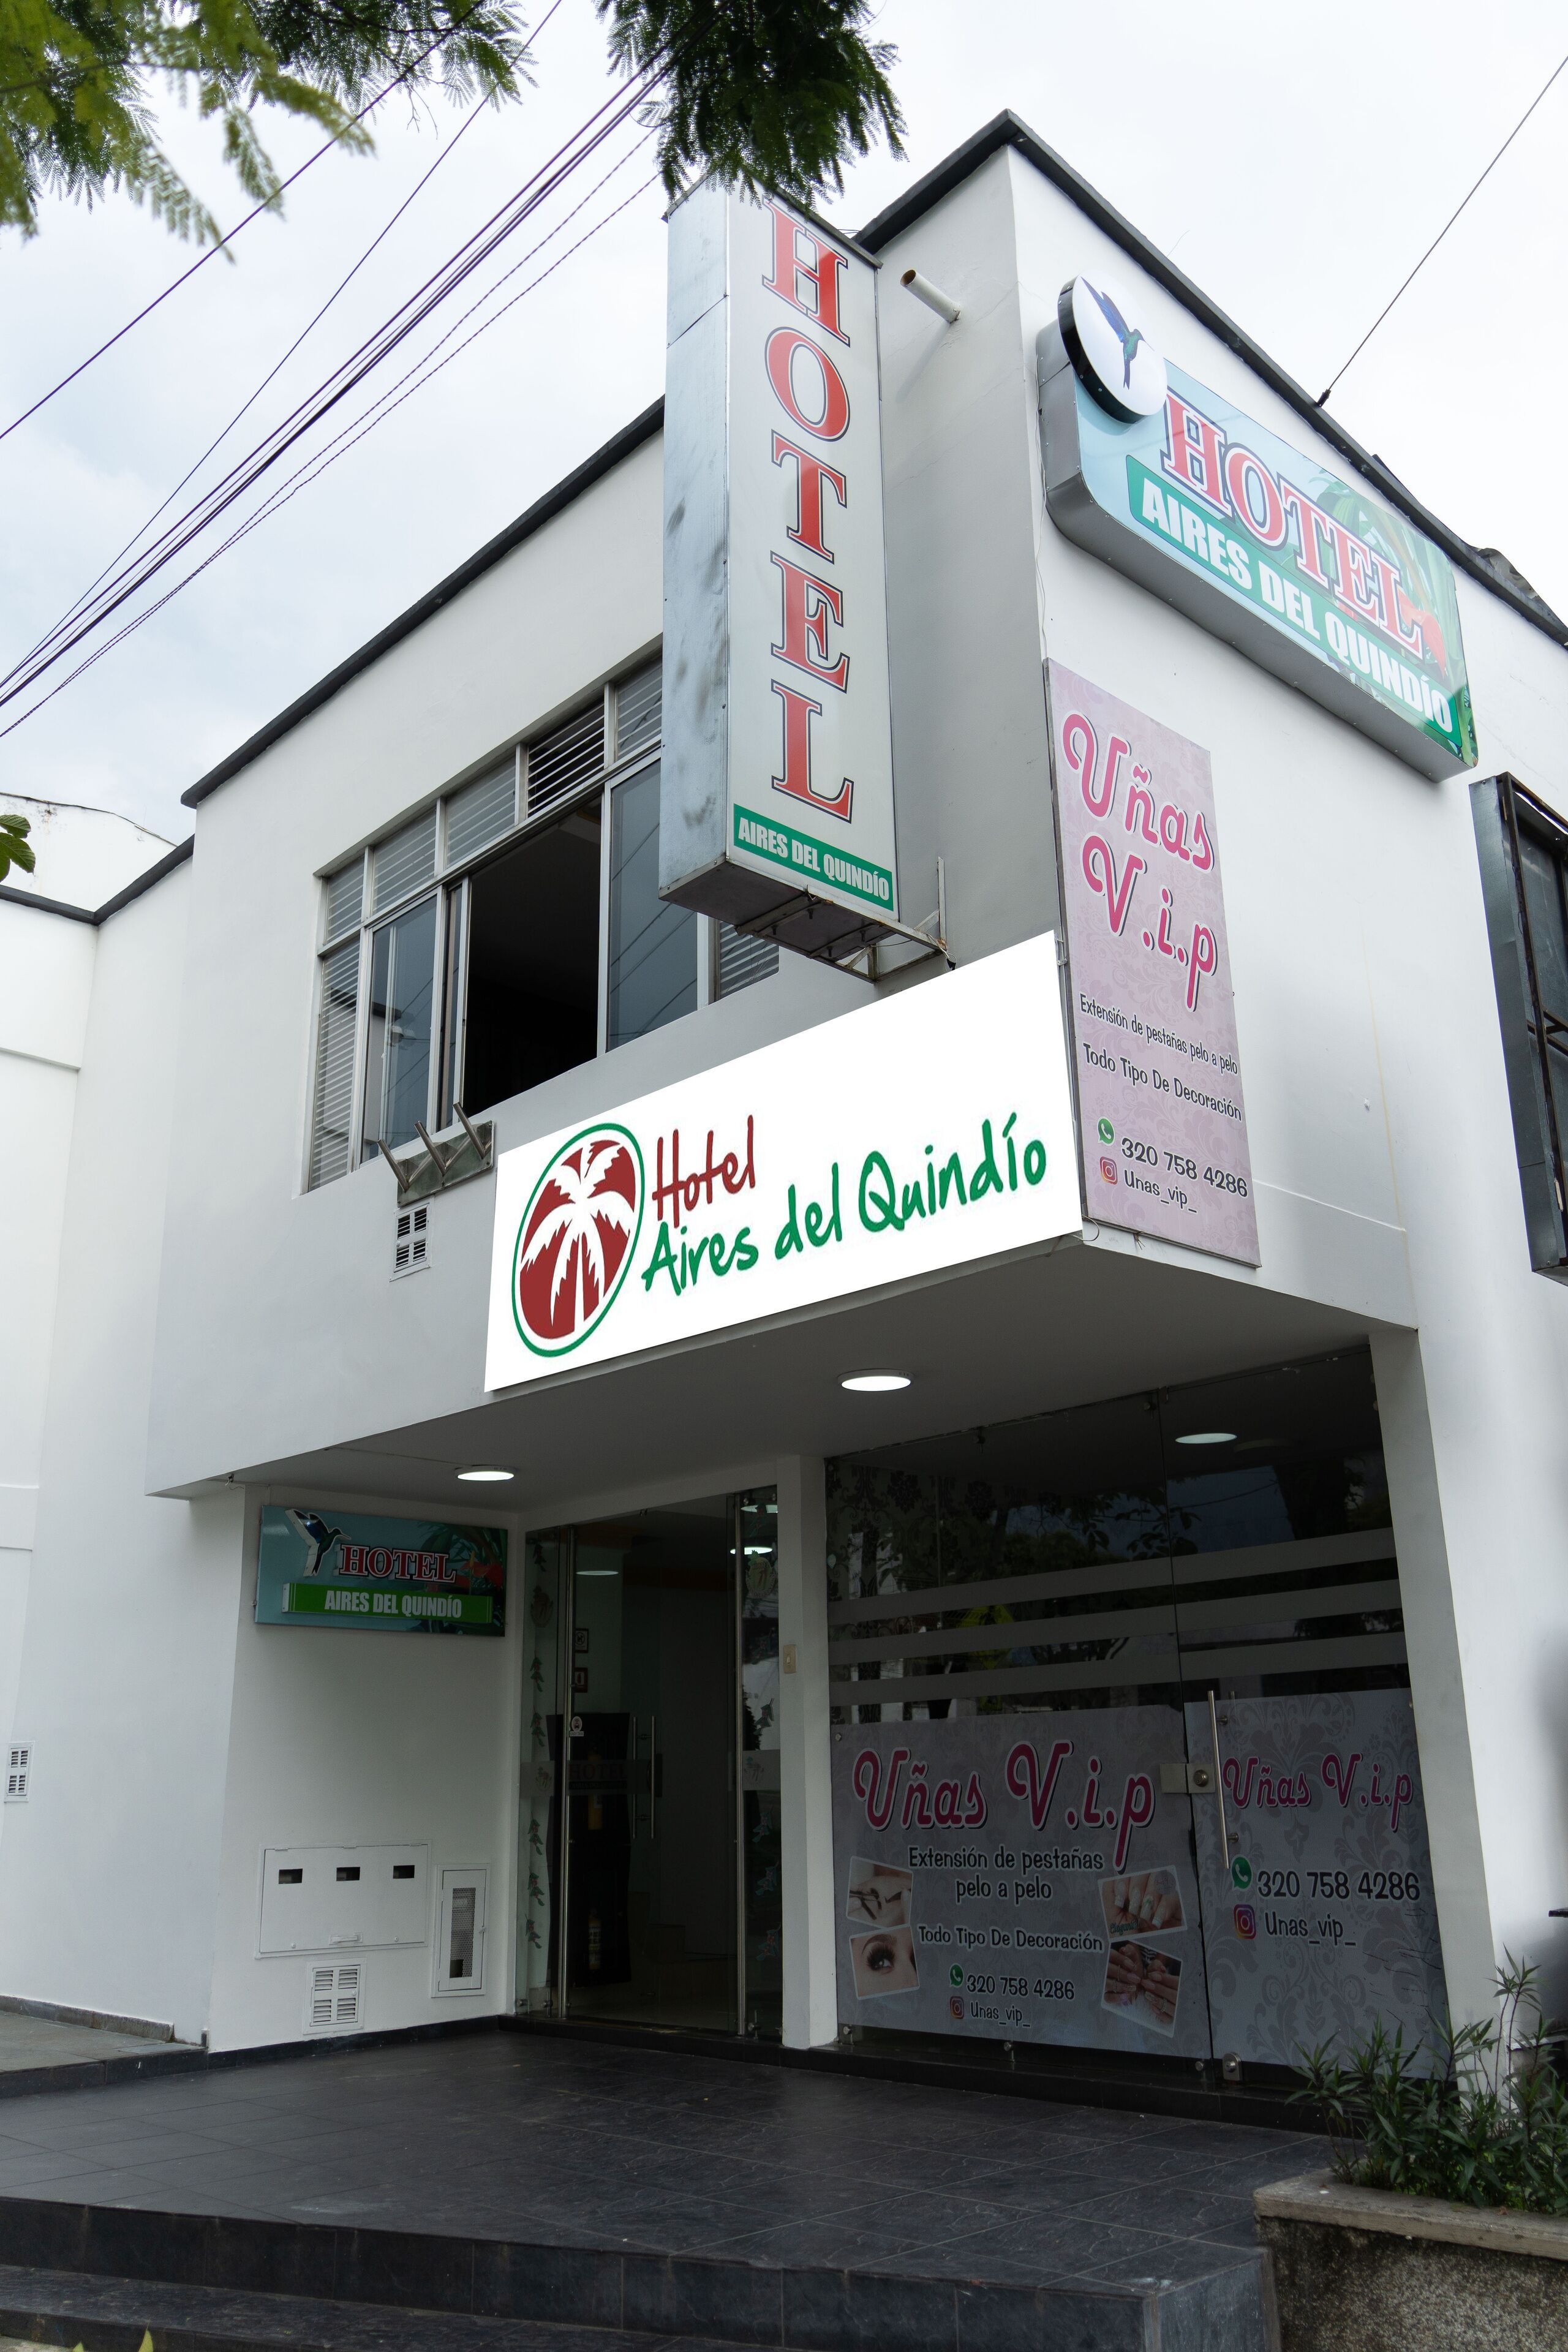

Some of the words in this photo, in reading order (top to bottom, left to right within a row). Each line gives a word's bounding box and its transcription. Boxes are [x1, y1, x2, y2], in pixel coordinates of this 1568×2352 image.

[762, 195, 854, 824] HOTEL
[1159, 387, 1423, 661] HOTEL
[1142, 478, 1253, 591] AIRES
[1258, 572, 1321, 641] DEL
[1327, 616, 1453, 734] QUINDÍO
[1061, 710, 1213, 872] Uñas
[739, 817, 787, 858] AIRES
[792, 839, 820, 872] DEL
[823, 854, 889, 900] QUINDÍO
[1081, 832, 1218, 1012] V.i.p
[1080, 993, 1128, 1030] Extensión
[1131, 1019, 1143, 1035] de
[1146, 1025, 1187, 1054] pestañas
[1190, 1042, 1209, 1062] pelo
[1212, 1054, 1217, 1066] a
[1219, 1054, 1238, 1076] pelo
[1083, 1043, 1116, 1072] Todo
[1120, 1057, 1148, 1087] Tipo
[1153, 1069, 1170, 1092] De
[1174, 1077, 1242, 1121] Decoración
[641, 1222, 758, 1296] Aires
[774, 1162, 842, 1259] del
[859, 1112, 1047, 1232] Quindío
[652, 1115, 755, 1228] Hotel
[1121, 1137, 1158, 1166] 320
[1164, 1152, 1197, 1180] 758
[1204, 1167, 1248, 1197] 4286
[324, 1590, 368, 1612] AIRES
[372, 1593, 398, 1614] DEL
[402, 1595, 462, 1618] QUINDÍO
[339, 1544, 458, 1584] HOTEL
[853, 1747, 988, 1832] Uñas
[1005, 1740, 1156, 1875] V.i.p
[1223, 1756, 1311, 1809] Uñas
[1321, 1752, 1414, 1832] V.i.p
[908, 1846, 987, 1868] Extensión
[994, 1846, 1016, 1868] de
[1022, 1849, 1103, 1875] pestañas
[956, 1875, 991, 1904] pelo
[998, 1884, 1008, 1897] a
[1014, 1875, 1052, 1905] pelo
[1257, 1870, 1300, 1898] 320
[1306, 1871, 1349, 1899] 758
[1358, 1871, 1420, 1901] 4286
[918, 1925, 951, 1943] Todo
[957, 1928, 985, 1949] Tipo
[991, 1929, 1010, 1946] De
[1016, 1930, 1102, 1952] Decoración
[967, 1974, 996, 1994] 320
[1000, 1977, 1028, 1996] 758
[1033, 1978, 1075, 2000] 4286
